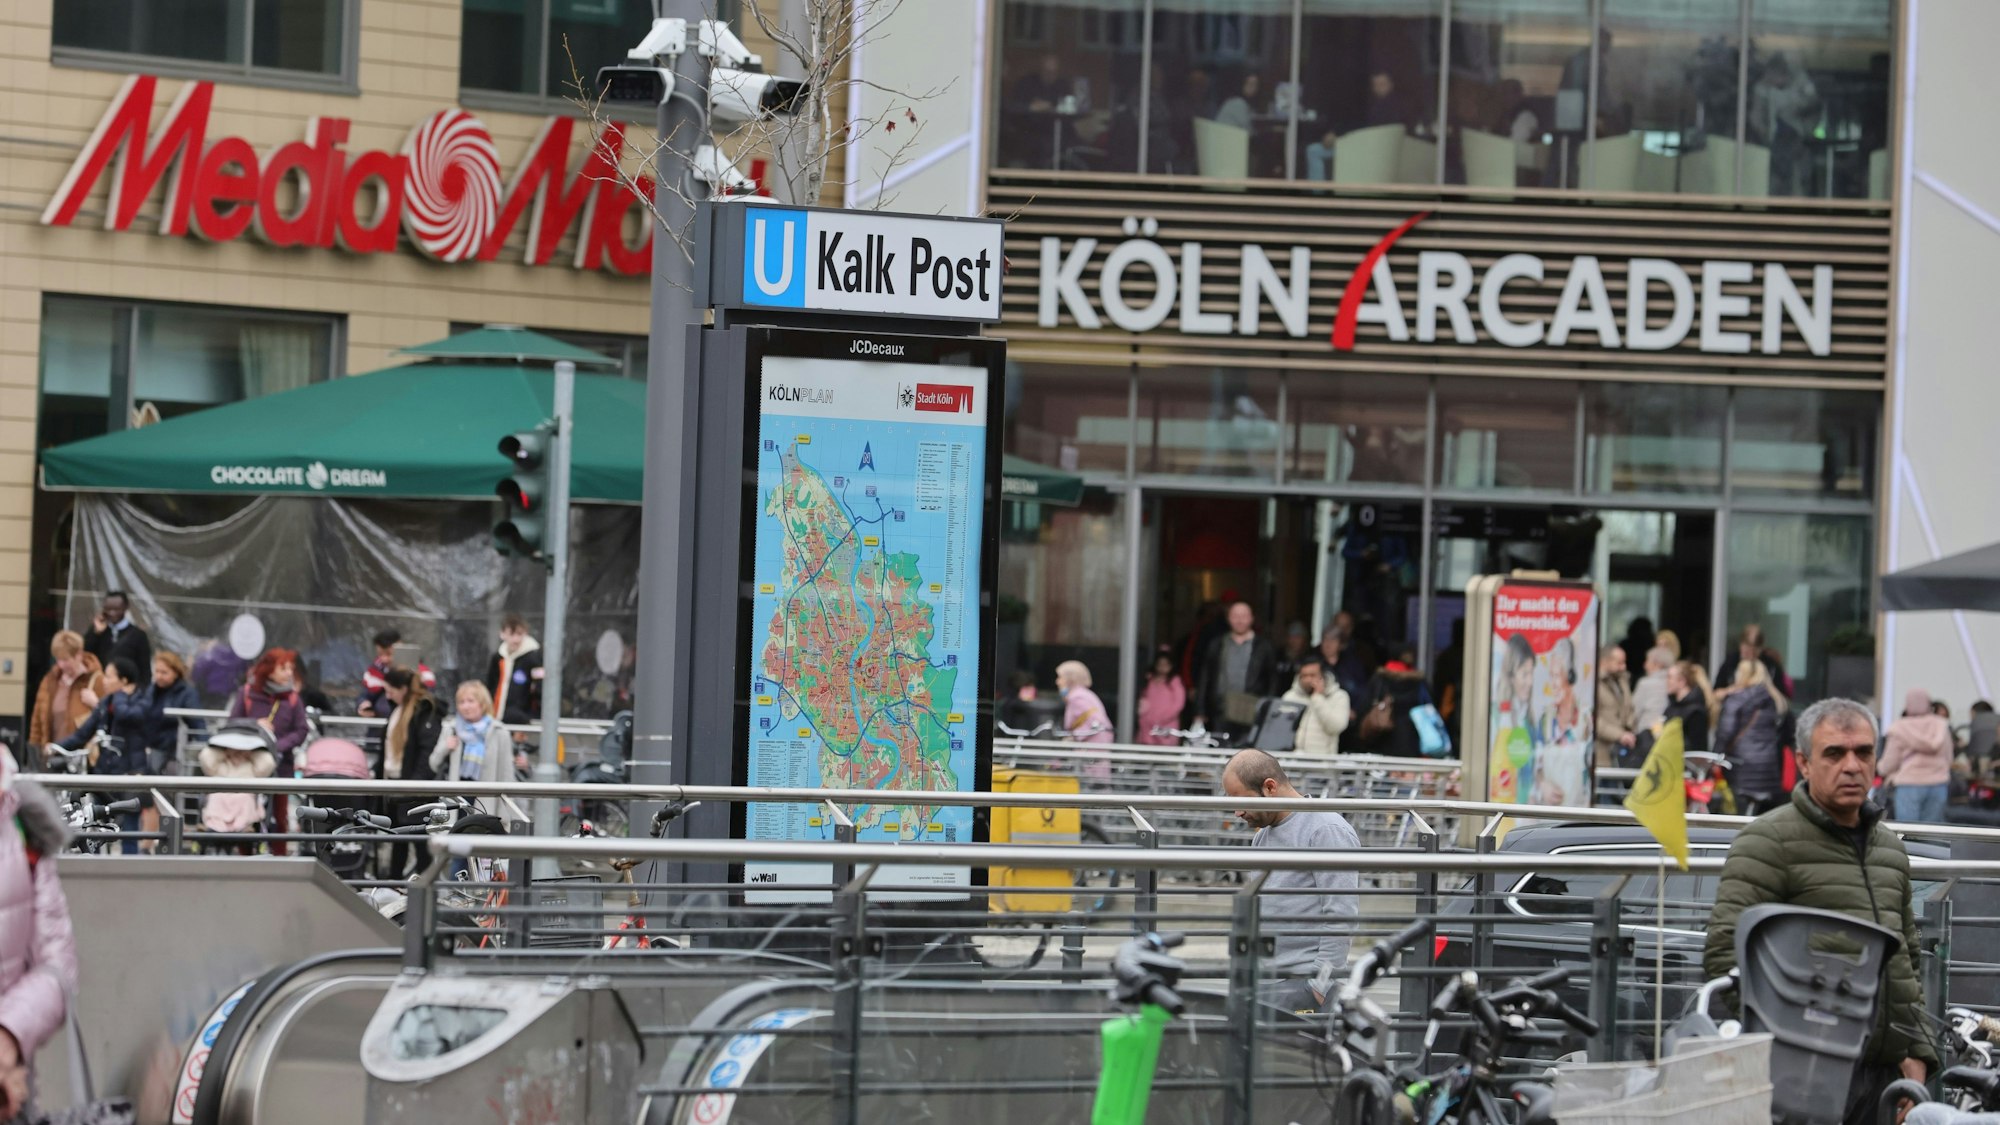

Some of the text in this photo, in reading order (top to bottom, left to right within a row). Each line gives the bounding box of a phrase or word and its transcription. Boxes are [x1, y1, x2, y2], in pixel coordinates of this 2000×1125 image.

[40, 74, 409, 253] Media
[753, 218, 991, 302] U Kalk Post
[1038, 211, 1834, 357] KÖLN ARCADEN
[849, 340, 905, 356] JCDecaux
[917, 392, 954, 405] Stadt Köln
[211, 465, 387, 487] CHOCOLATE DREAM
[1519, 595, 1555, 612] macht
[1557, 596, 1580, 613] den
[759, 872, 777, 883] Wall
